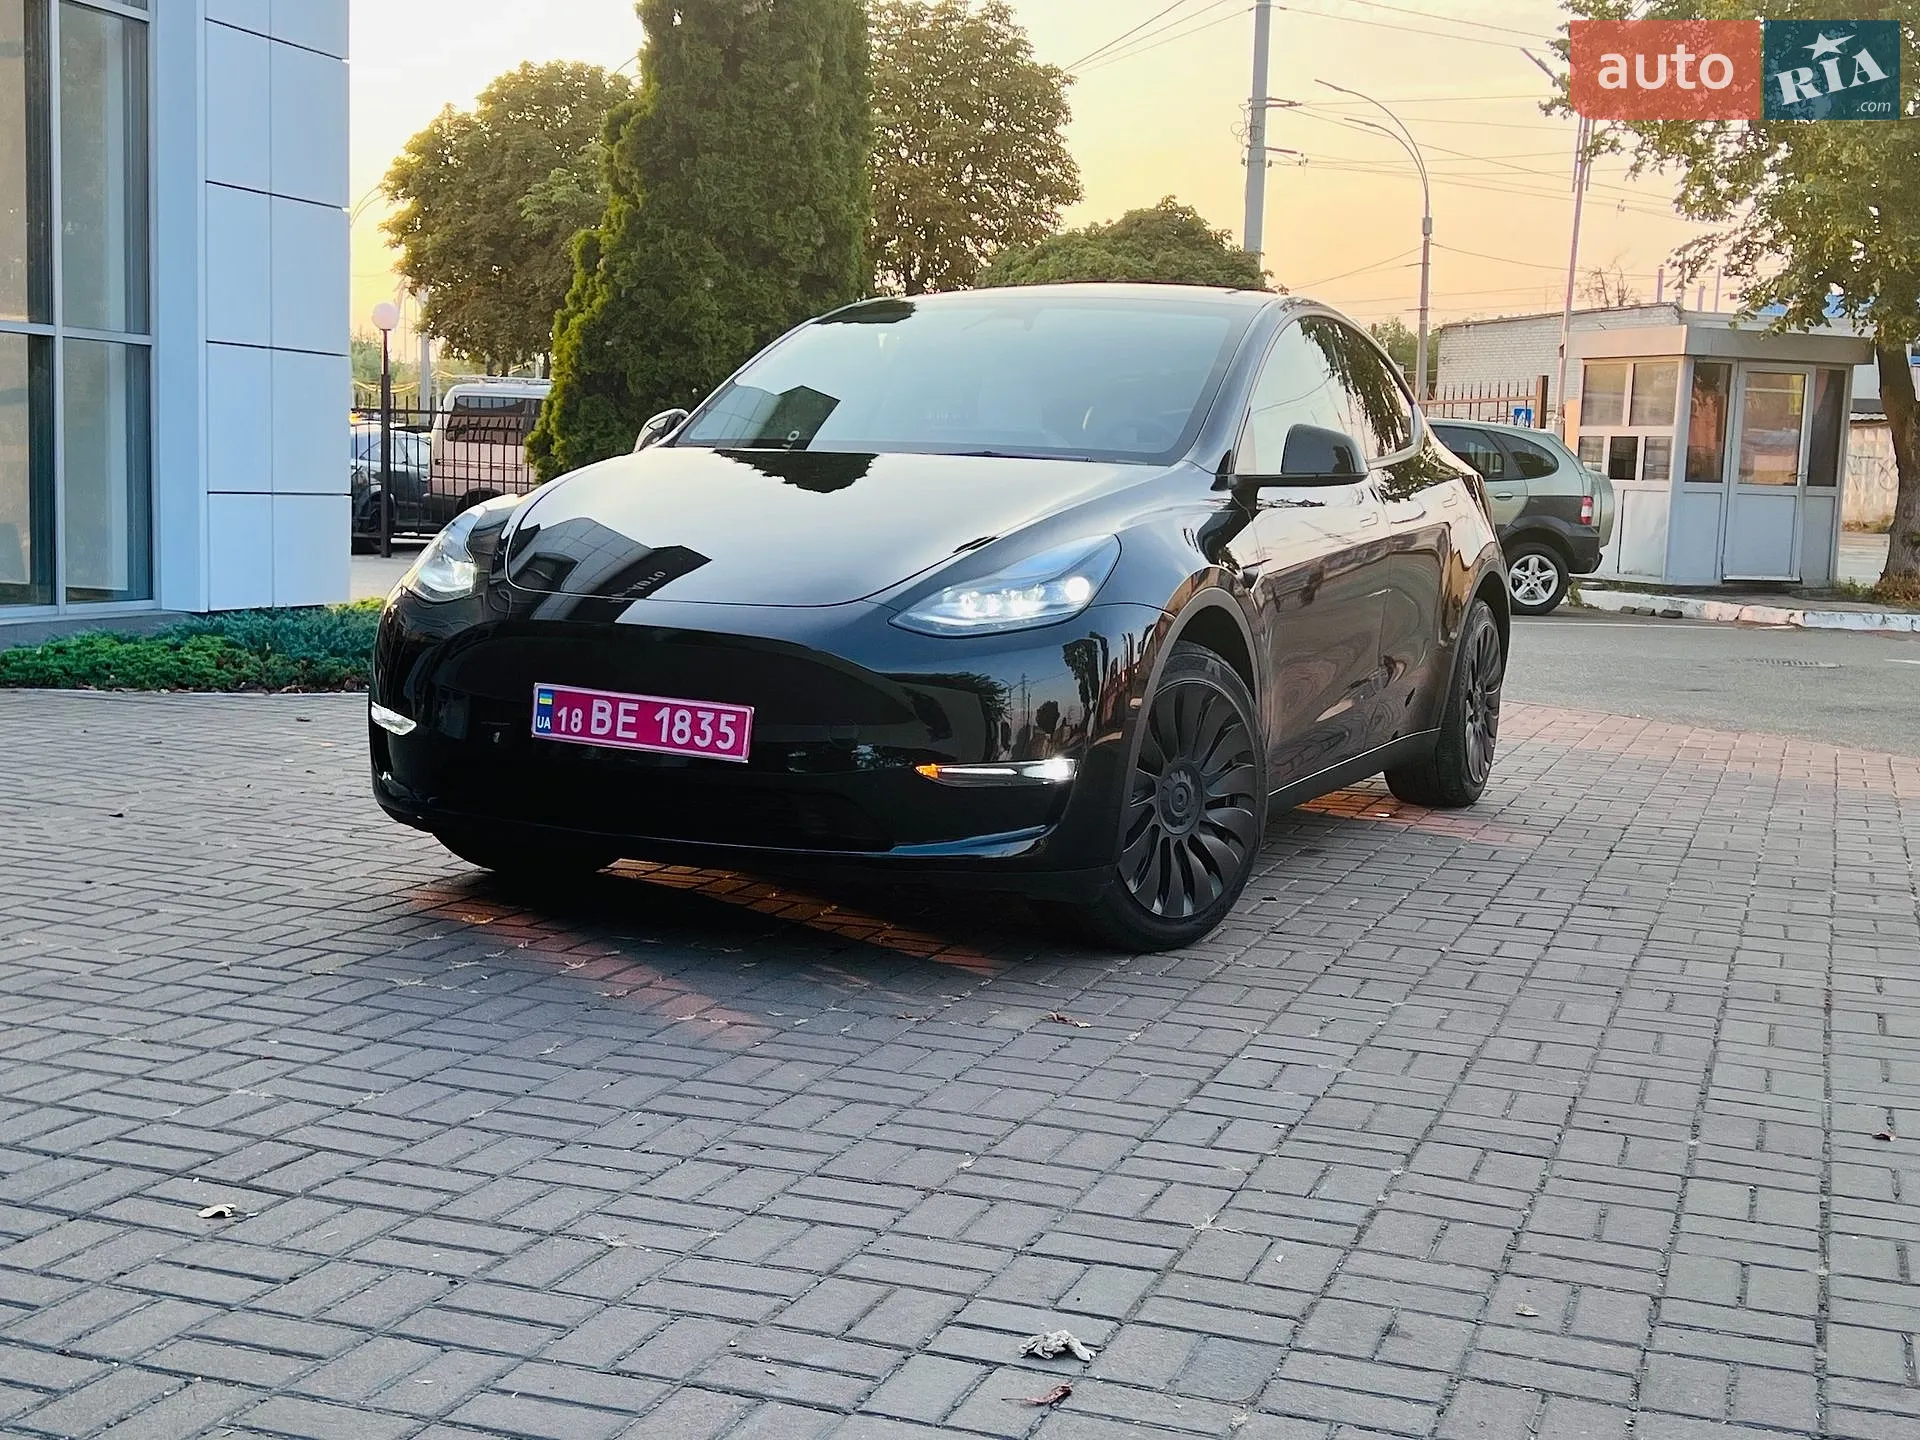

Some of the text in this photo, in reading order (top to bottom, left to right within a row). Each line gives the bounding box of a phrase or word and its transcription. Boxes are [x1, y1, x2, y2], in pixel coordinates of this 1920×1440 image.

[537, 716, 551, 730] UA
[557, 699, 736, 750] 18 BE 1835
